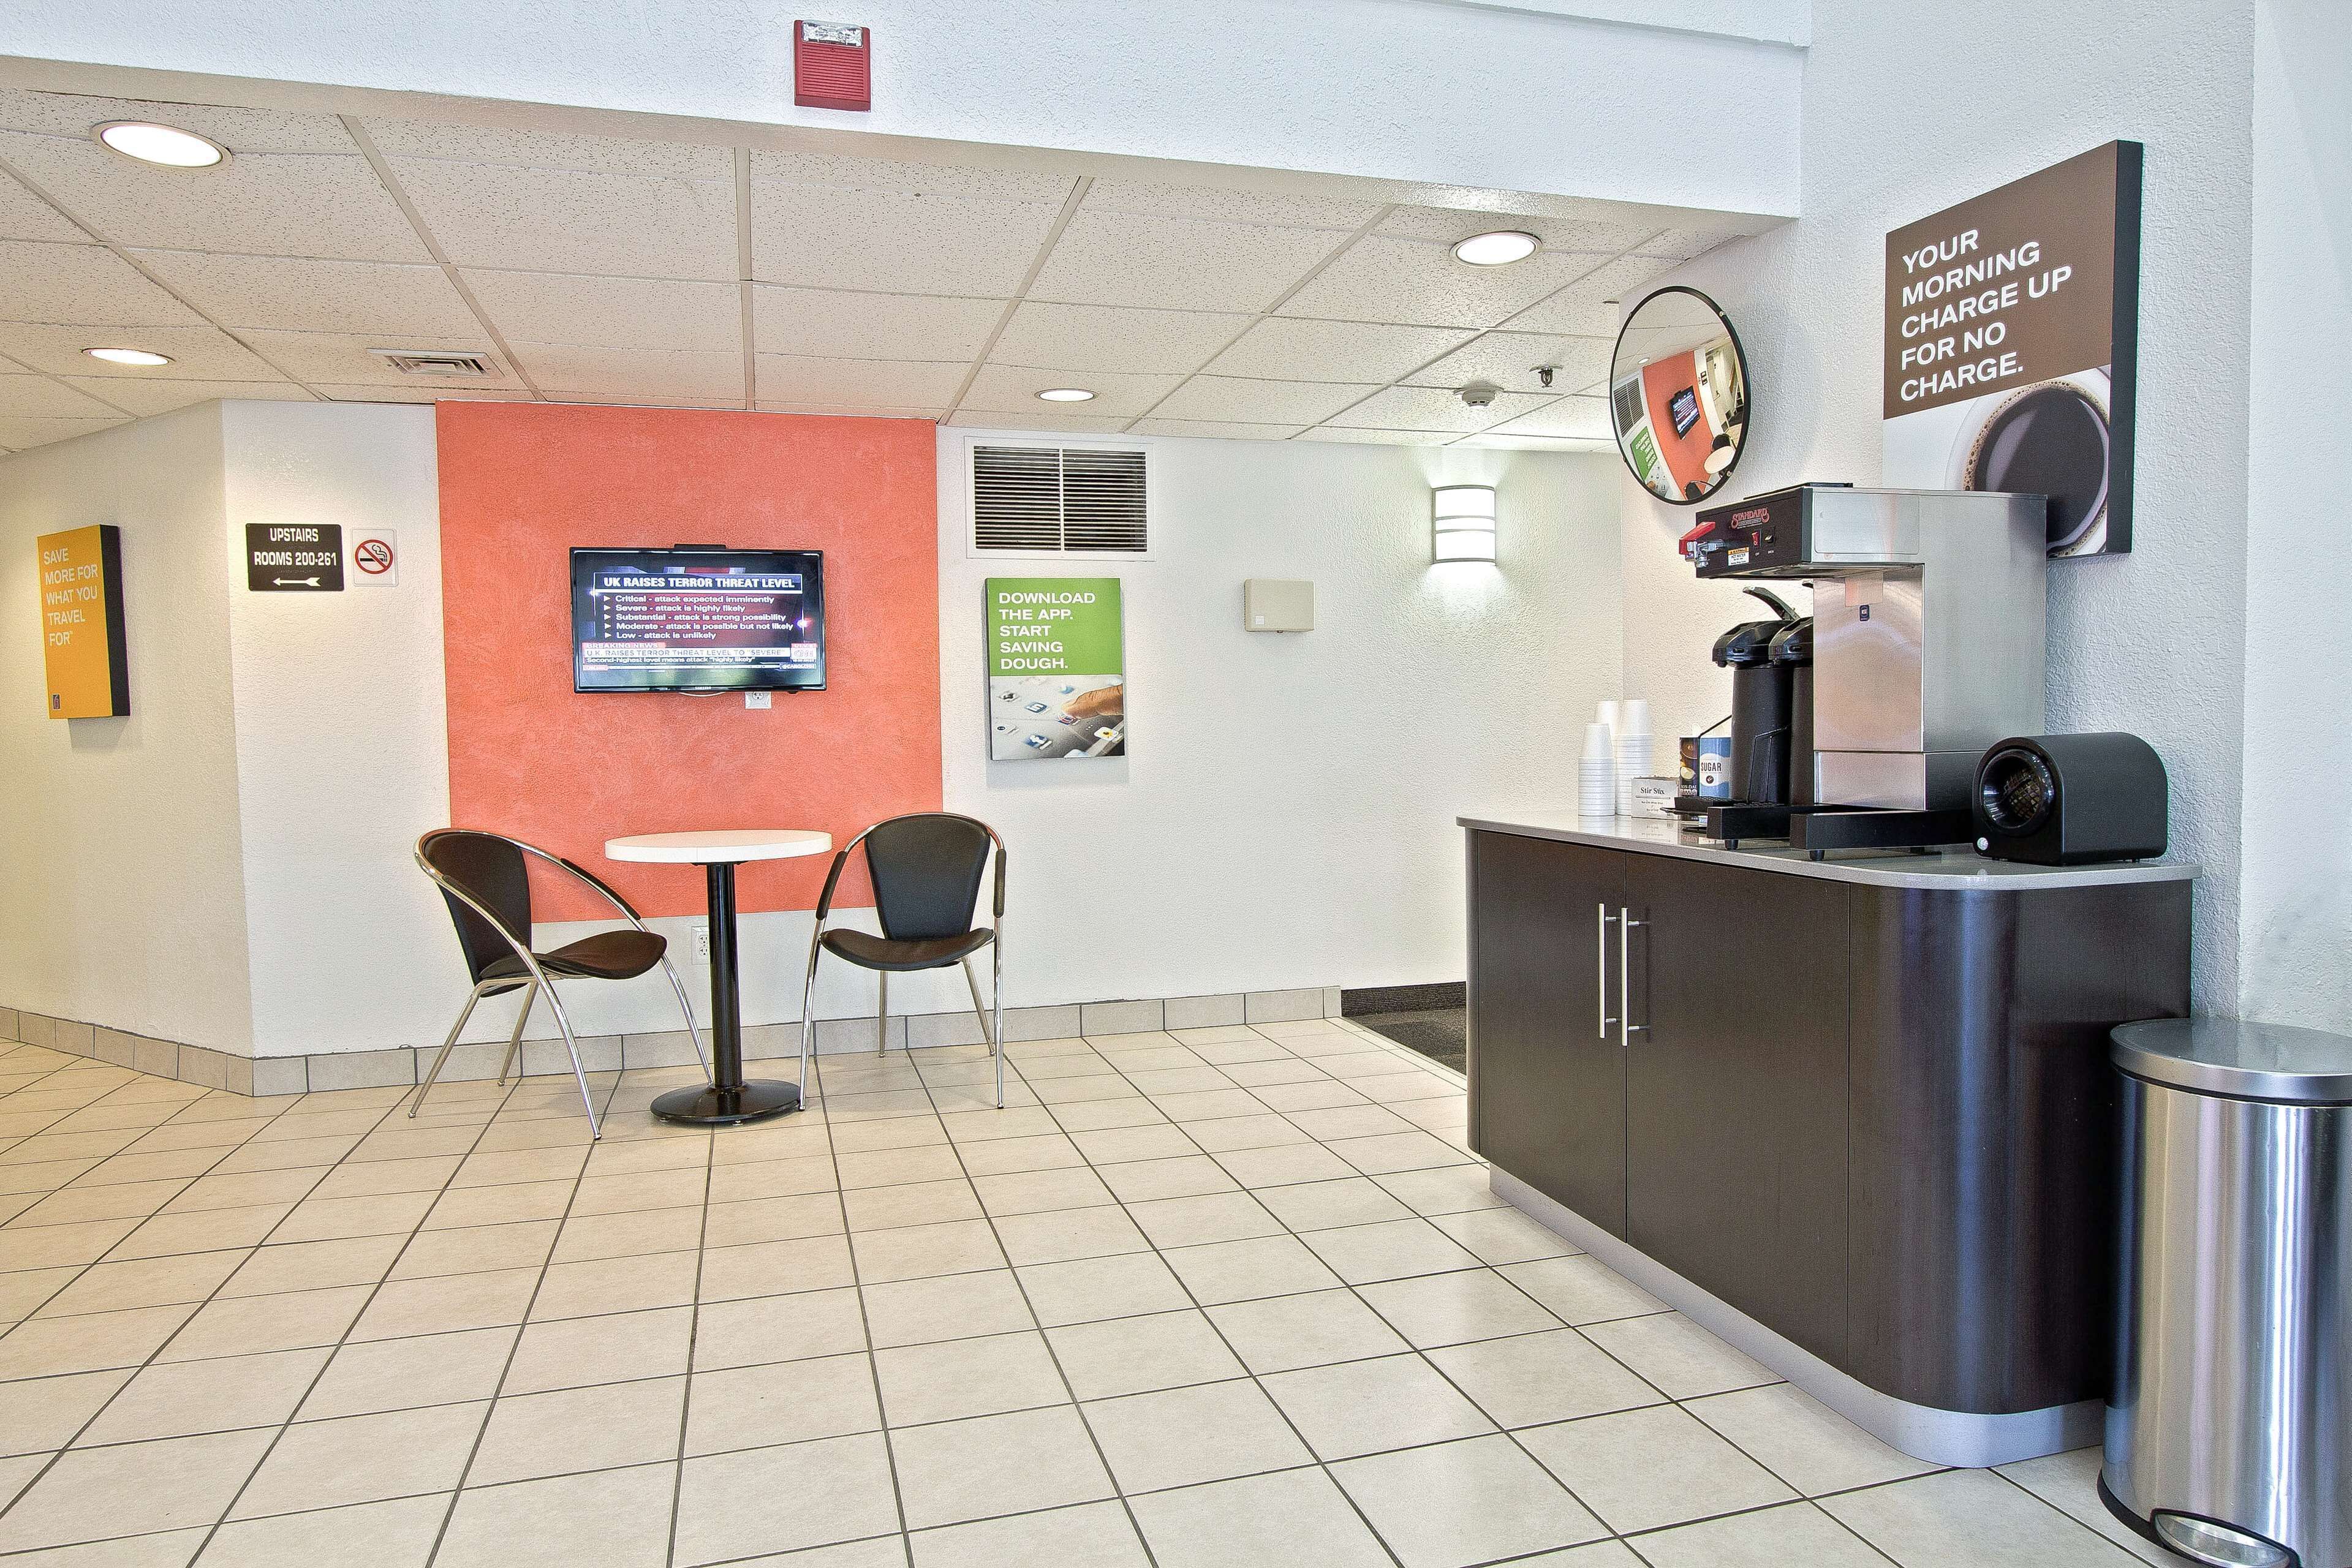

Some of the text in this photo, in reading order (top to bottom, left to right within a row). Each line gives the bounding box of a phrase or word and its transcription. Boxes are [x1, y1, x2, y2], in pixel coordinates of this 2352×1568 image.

[1902, 229, 1979, 274] YOUR
[1902, 241, 2040, 307] MORNING
[1901, 266, 2072, 337] CHARGE UP
[1901, 322, 2006, 371] FOR NO
[1900, 352, 2023, 401] CHARGE.
[1731, 508, 1770, 529] STANDARD
[270, 528, 319, 542] UPSTAIRS
[43, 548, 69, 565] SAVE
[254, 552, 336, 565] ROOMS 200-261
[45, 564, 98, 585] MORE FOR
[603, 577, 795, 588] UK RAISES TERROR THREAT LEVEL
[46, 585, 98, 605] WHAT YOU
[999, 592, 1096, 604] DOWNLOAD
[48, 608, 86, 625] TRAVEL
[999, 609, 1073, 620] THE APP.
[999, 625, 1051, 636] START
[1000, 641, 1063, 653] SAVING
[1000, 658, 1068, 669] DOUGH.
[1701, 762, 1722, 771] SUGAR
